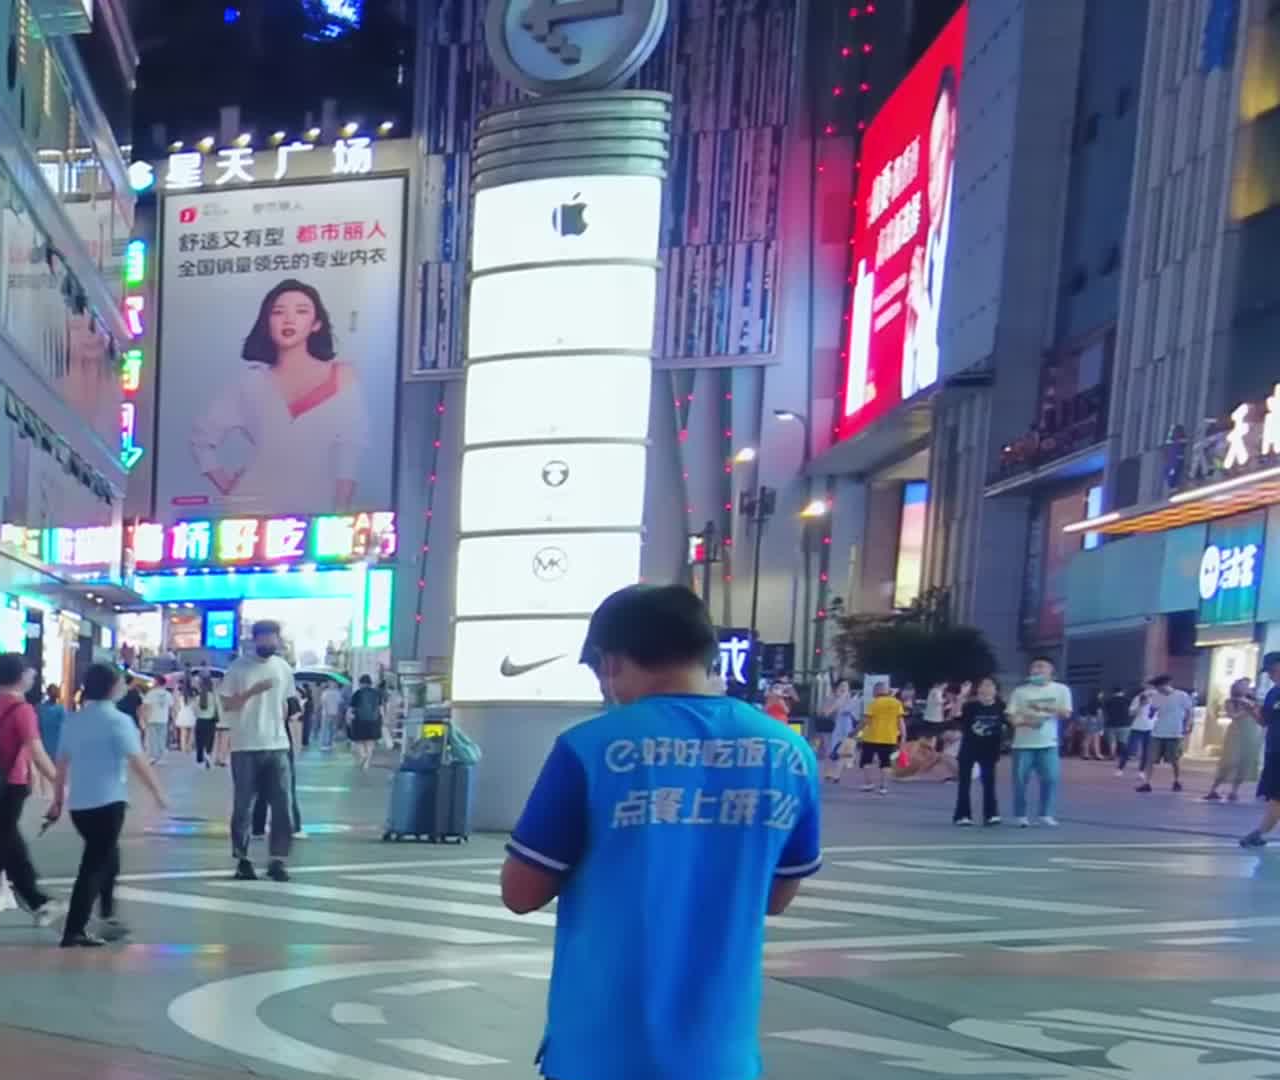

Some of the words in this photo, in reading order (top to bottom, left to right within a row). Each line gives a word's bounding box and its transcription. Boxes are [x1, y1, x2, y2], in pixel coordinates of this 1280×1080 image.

[165, 137, 374, 190] 星天广场
[178, 226, 284, 252] 舒适又有型
[296, 219, 387, 243] 都市丽人
[178, 248, 387, 278] 全国销量领先的专业内衣
